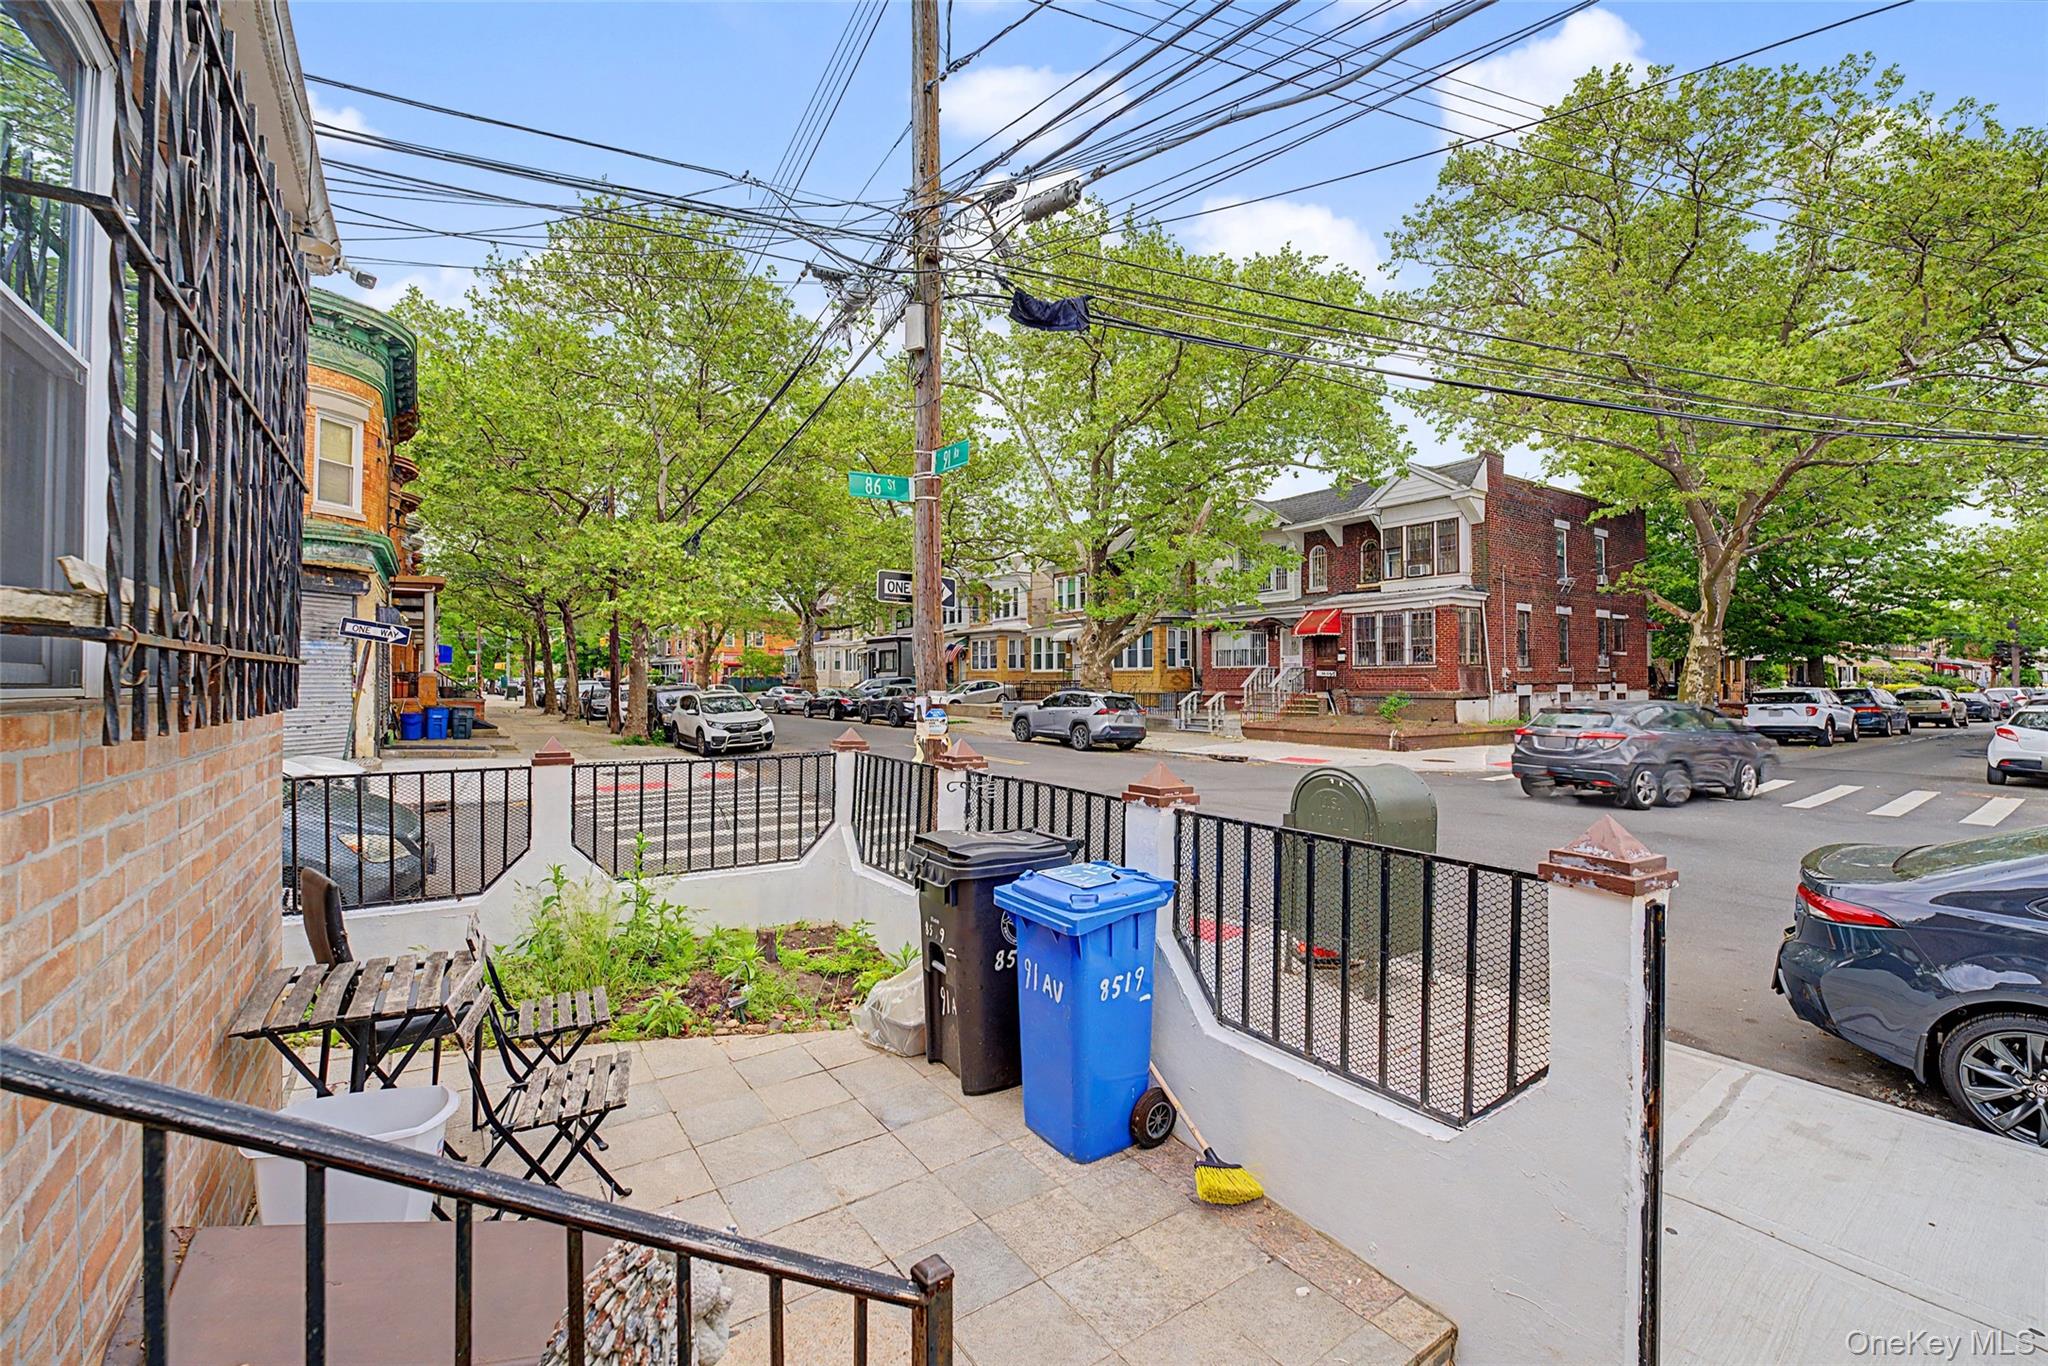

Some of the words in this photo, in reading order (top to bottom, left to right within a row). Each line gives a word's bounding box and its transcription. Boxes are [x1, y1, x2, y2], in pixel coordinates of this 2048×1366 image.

[943, 448, 951, 470] 91
[865, 476, 881, 495] 86
[887, 580, 911, 594] ONE
[352, 624, 371, 634] ONE
[380, 629, 399, 639] WAY
[1024, 958, 1037, 992] 91
[1042, 973, 1063, 1004] AV
[1100, 966, 1145, 1001] 8519
